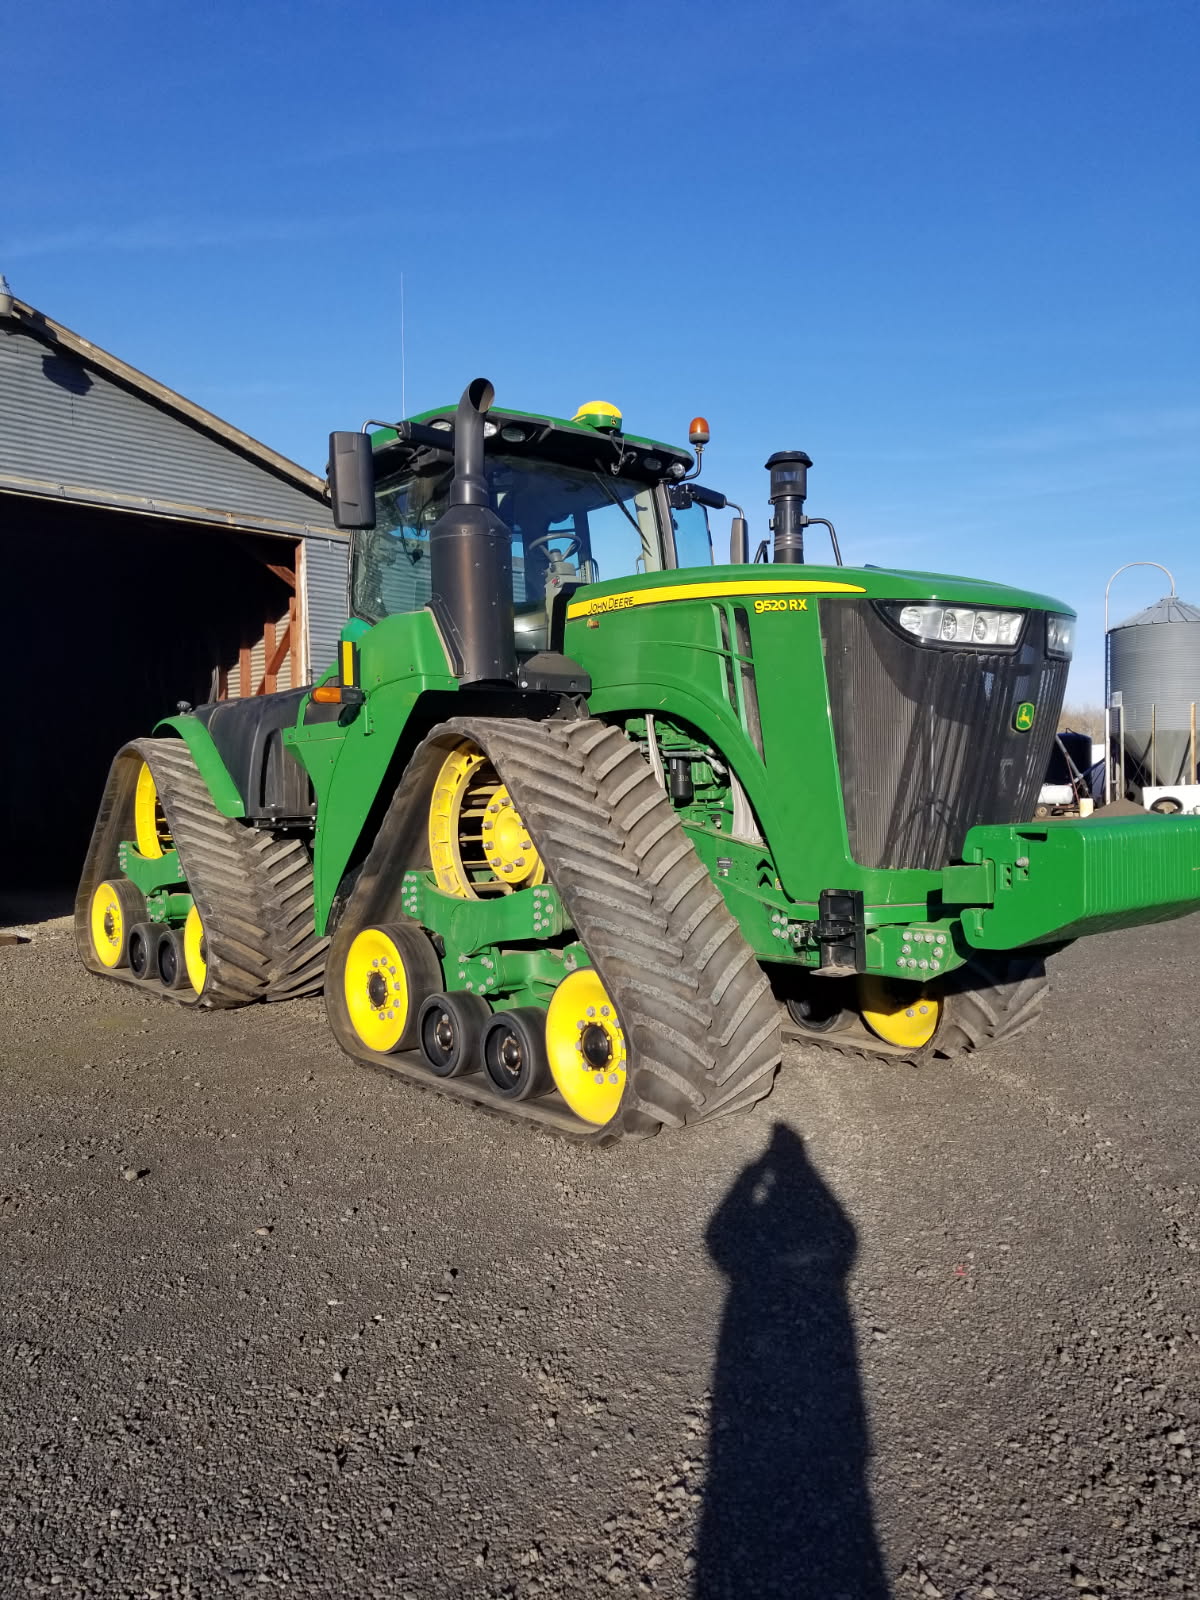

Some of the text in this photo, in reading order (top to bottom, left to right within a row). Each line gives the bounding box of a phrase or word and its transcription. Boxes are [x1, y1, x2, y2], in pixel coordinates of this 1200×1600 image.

[587, 596, 634, 615] JOHN DEERE
[754, 598, 808, 614] 9520 RX
